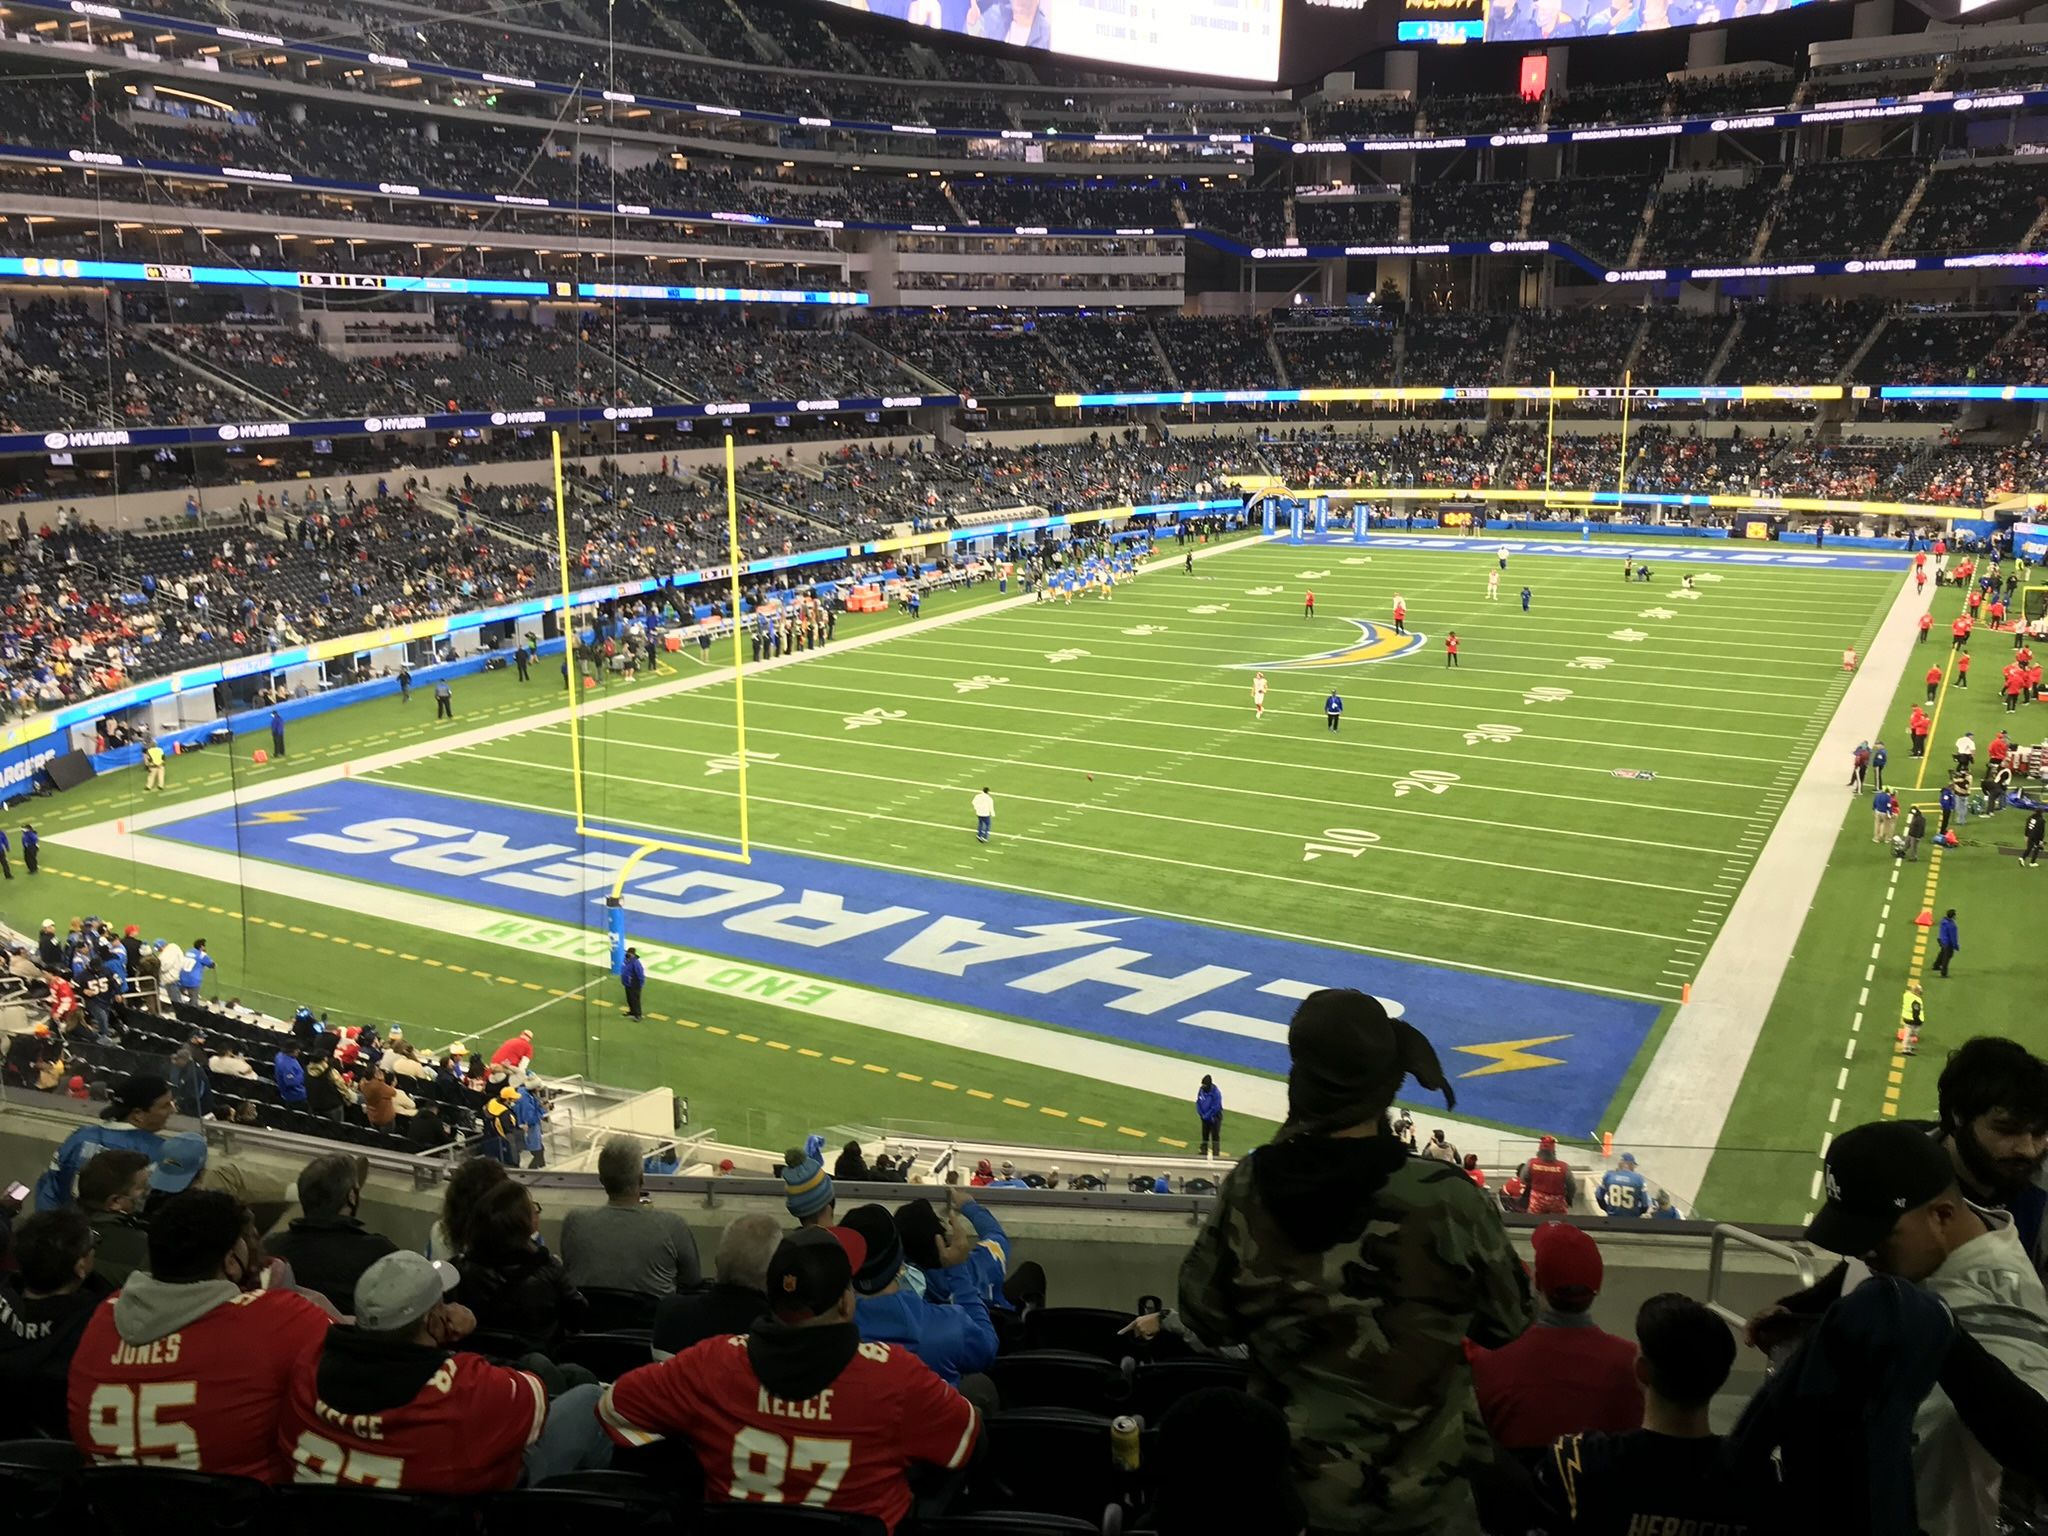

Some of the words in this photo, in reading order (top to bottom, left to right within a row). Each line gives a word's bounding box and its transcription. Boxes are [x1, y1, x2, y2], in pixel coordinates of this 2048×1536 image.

[1974, 95, 2024, 108] HYUNDAI
[1729, 117, 1775, 128] HYUNDAI
[1802, 111, 1853, 122] INTRODUCING
[1855, 109, 1870, 118] THE
[1506, 134, 1548, 144] HYUNDAI
[1308, 143, 1346, 152] HYUNDAI
[1268, 248, 1307, 257] HYUNDAI
[1507, 241, 1549, 250] HYUNDAI
[1691, 268, 1745, 278] INTRODUCING
[1866, 259, 1916, 271] HYUNDAI
[1621, 271, 1666, 281] HYUNDAI
[240, 423, 290, 438] HYUNDAI
[382, 416, 427, 431] HYUNDAI
[70, 430, 130, 448] HYUNDAI
[1463, 723, 1524, 744] 30
[1392, 769, 1462, 796] 20
[1303, 827, 1382, 859] 10
[478, 920, 700, 976] RCISM
[87, 976, 109, 995] 55
[704, 967, 838, 1007] END
[1609, 1184, 1635, 1209] 85
[111, 1333, 182, 1365] JONES
[757, 1384, 834, 1421] KELCE
[89, 1380, 203, 1471] 95
[728, 1426, 853, 1508] 87
